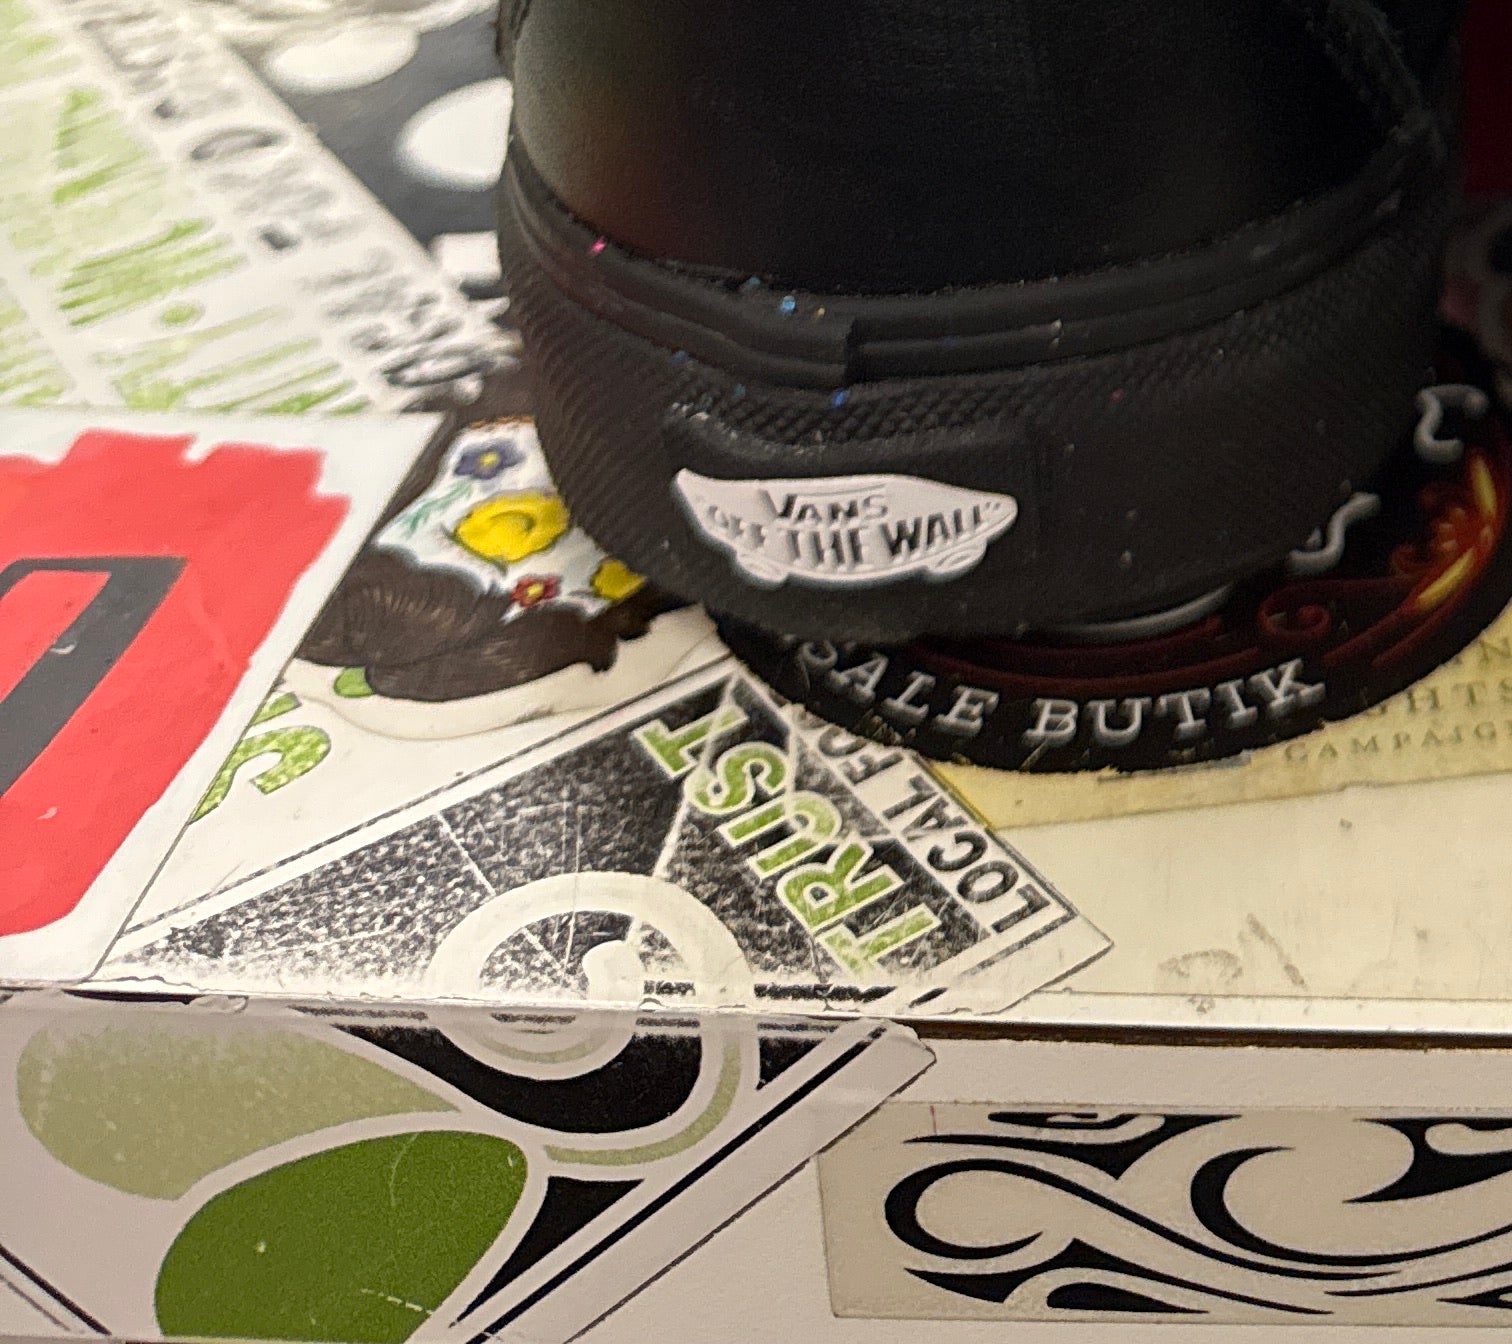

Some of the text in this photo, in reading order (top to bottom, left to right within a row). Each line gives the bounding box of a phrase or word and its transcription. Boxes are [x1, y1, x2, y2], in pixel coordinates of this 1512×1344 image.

[757, 486, 889, 525] VANS
[1021, 658, 1327, 746] BUTIK
[632, 702, 942, 978] TRUST
[882, 774, 1051, 933] LOCAL
